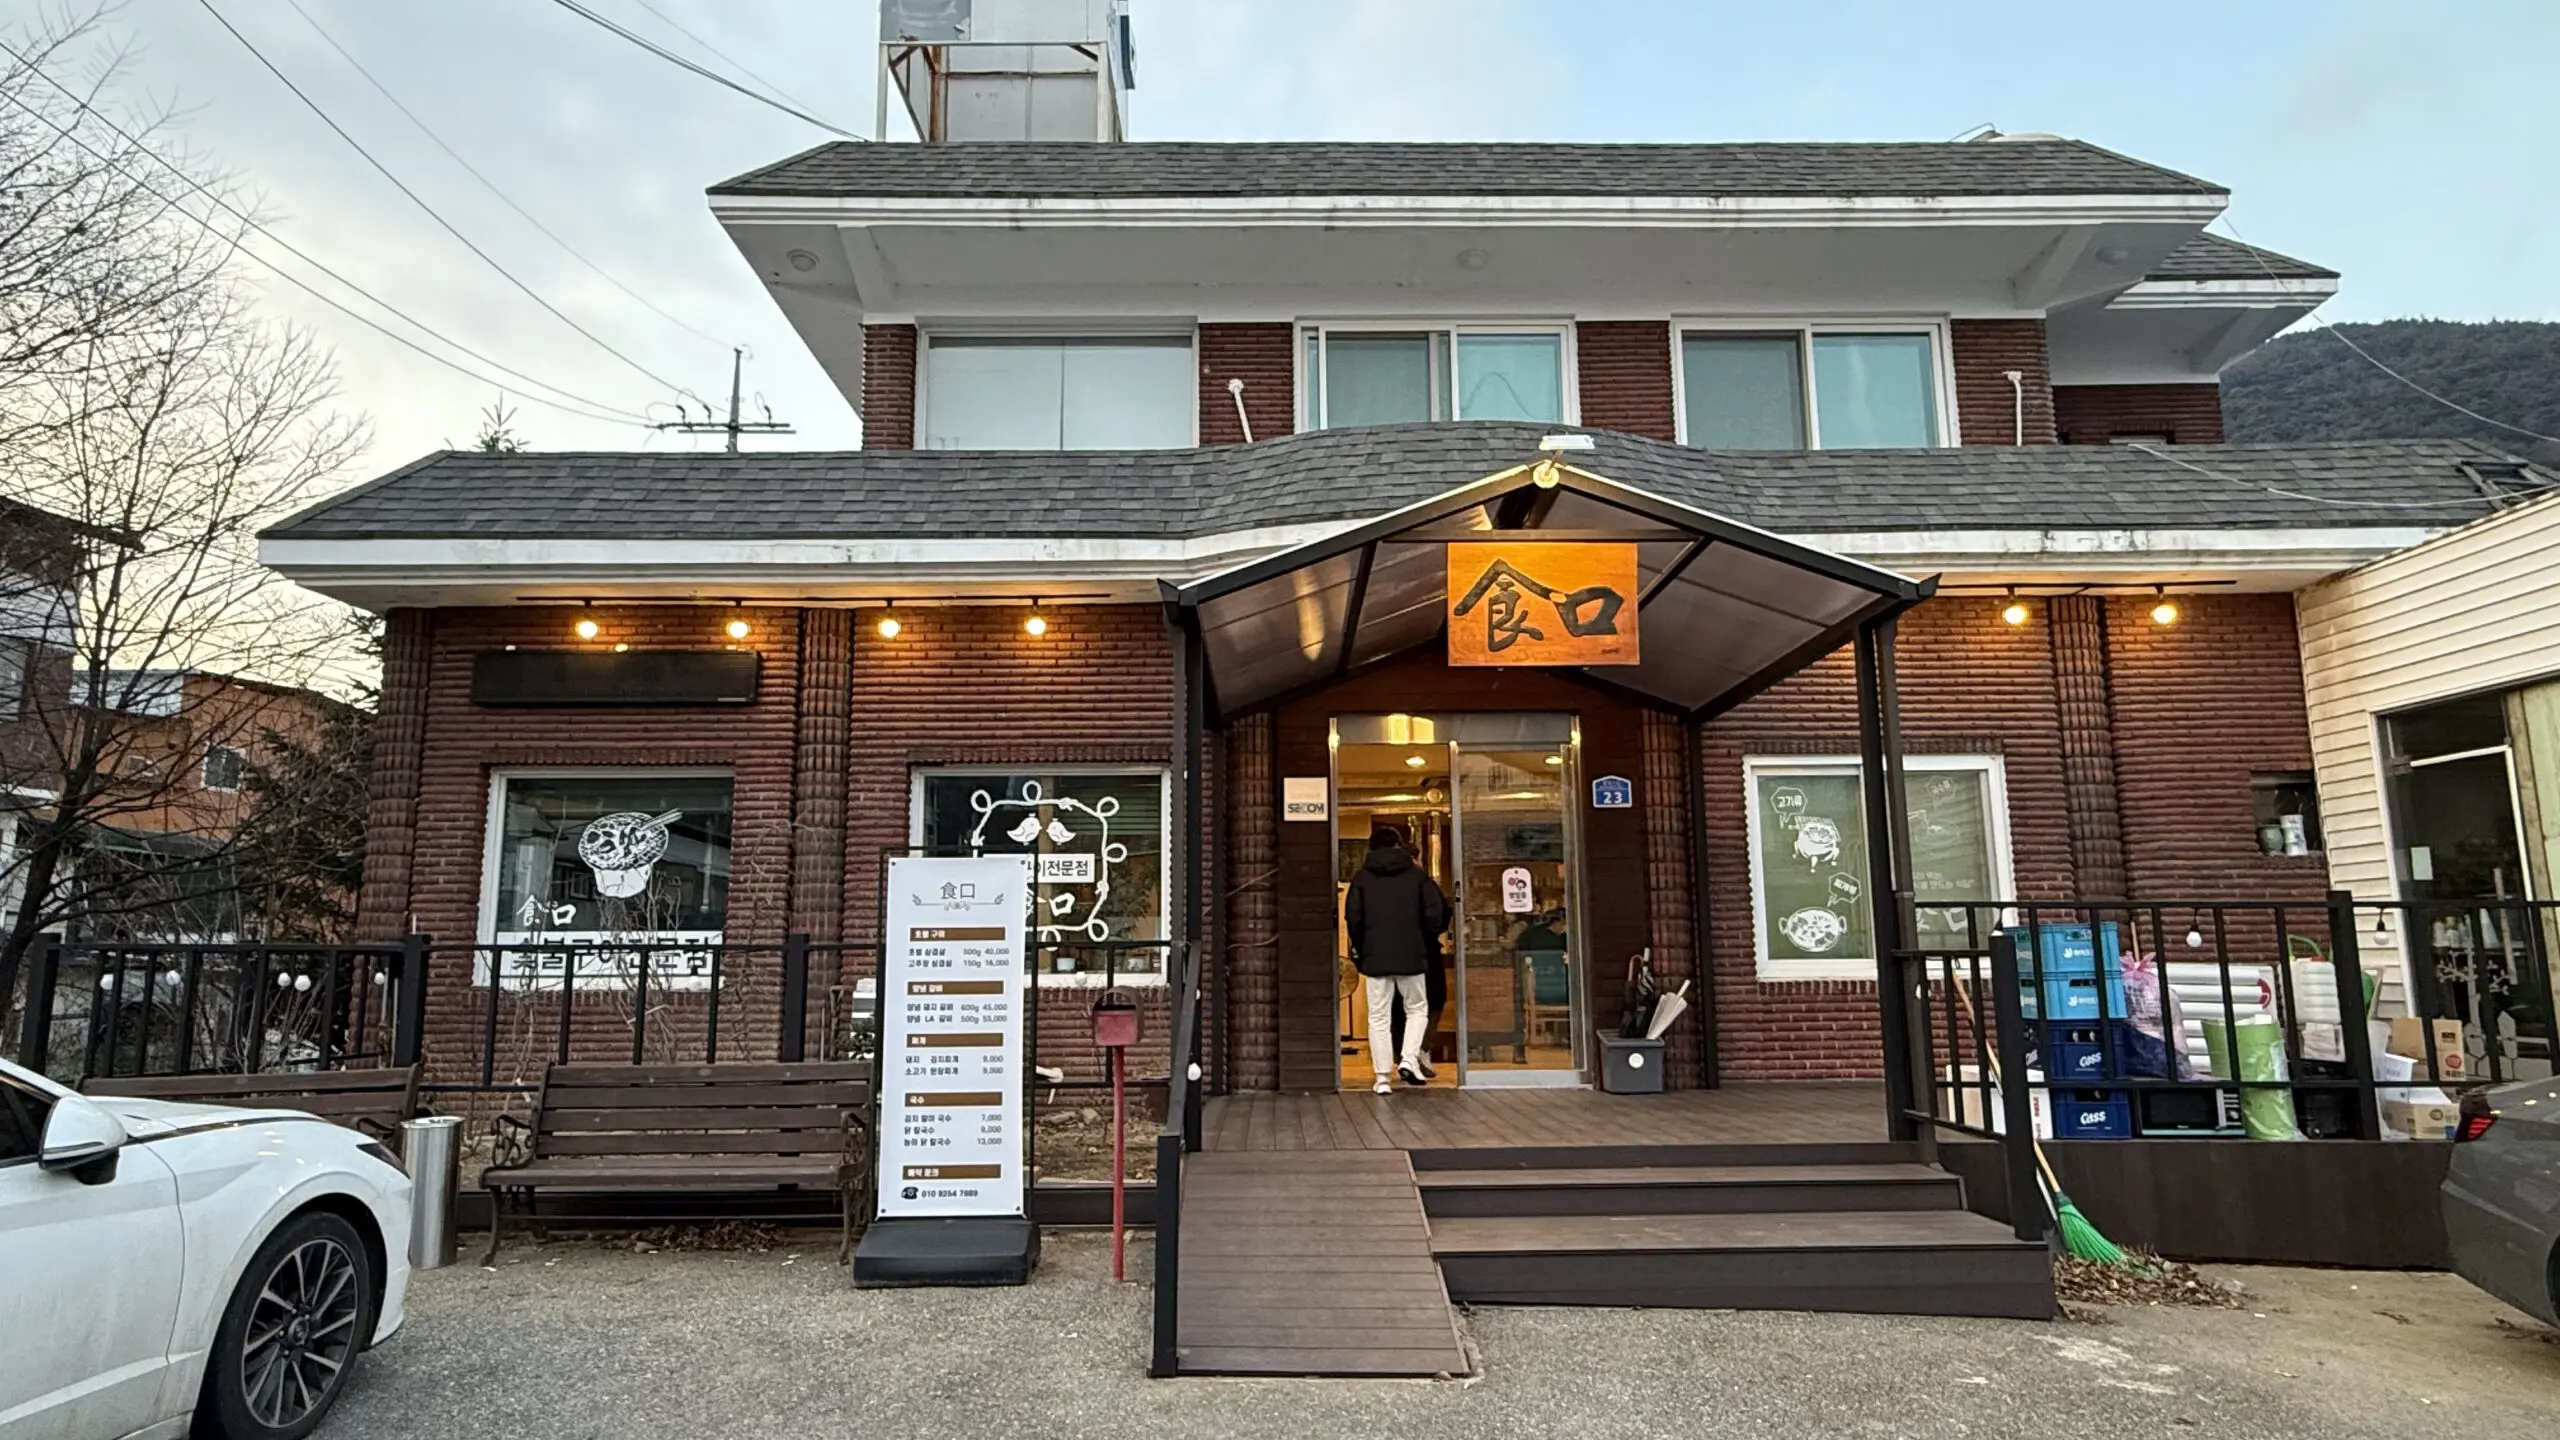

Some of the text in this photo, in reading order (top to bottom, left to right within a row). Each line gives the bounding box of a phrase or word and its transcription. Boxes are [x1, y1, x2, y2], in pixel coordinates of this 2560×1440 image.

[1454, 558, 1624, 652] 食口
[1603, 791, 1623, 804] 23
[940, 882, 976, 899] 食口
[908, 960, 929, 968] 고추장
[932, 960, 953, 968] 삼겹살
[925, 1015, 935, 1023] LA
[930, 1055, 959, 1063] 김치찌개
[904, 1067, 927, 1075] 소고기
[930, 1067, 959, 1075] 된장찌개
[921, 1190, 936, 1198] 010
